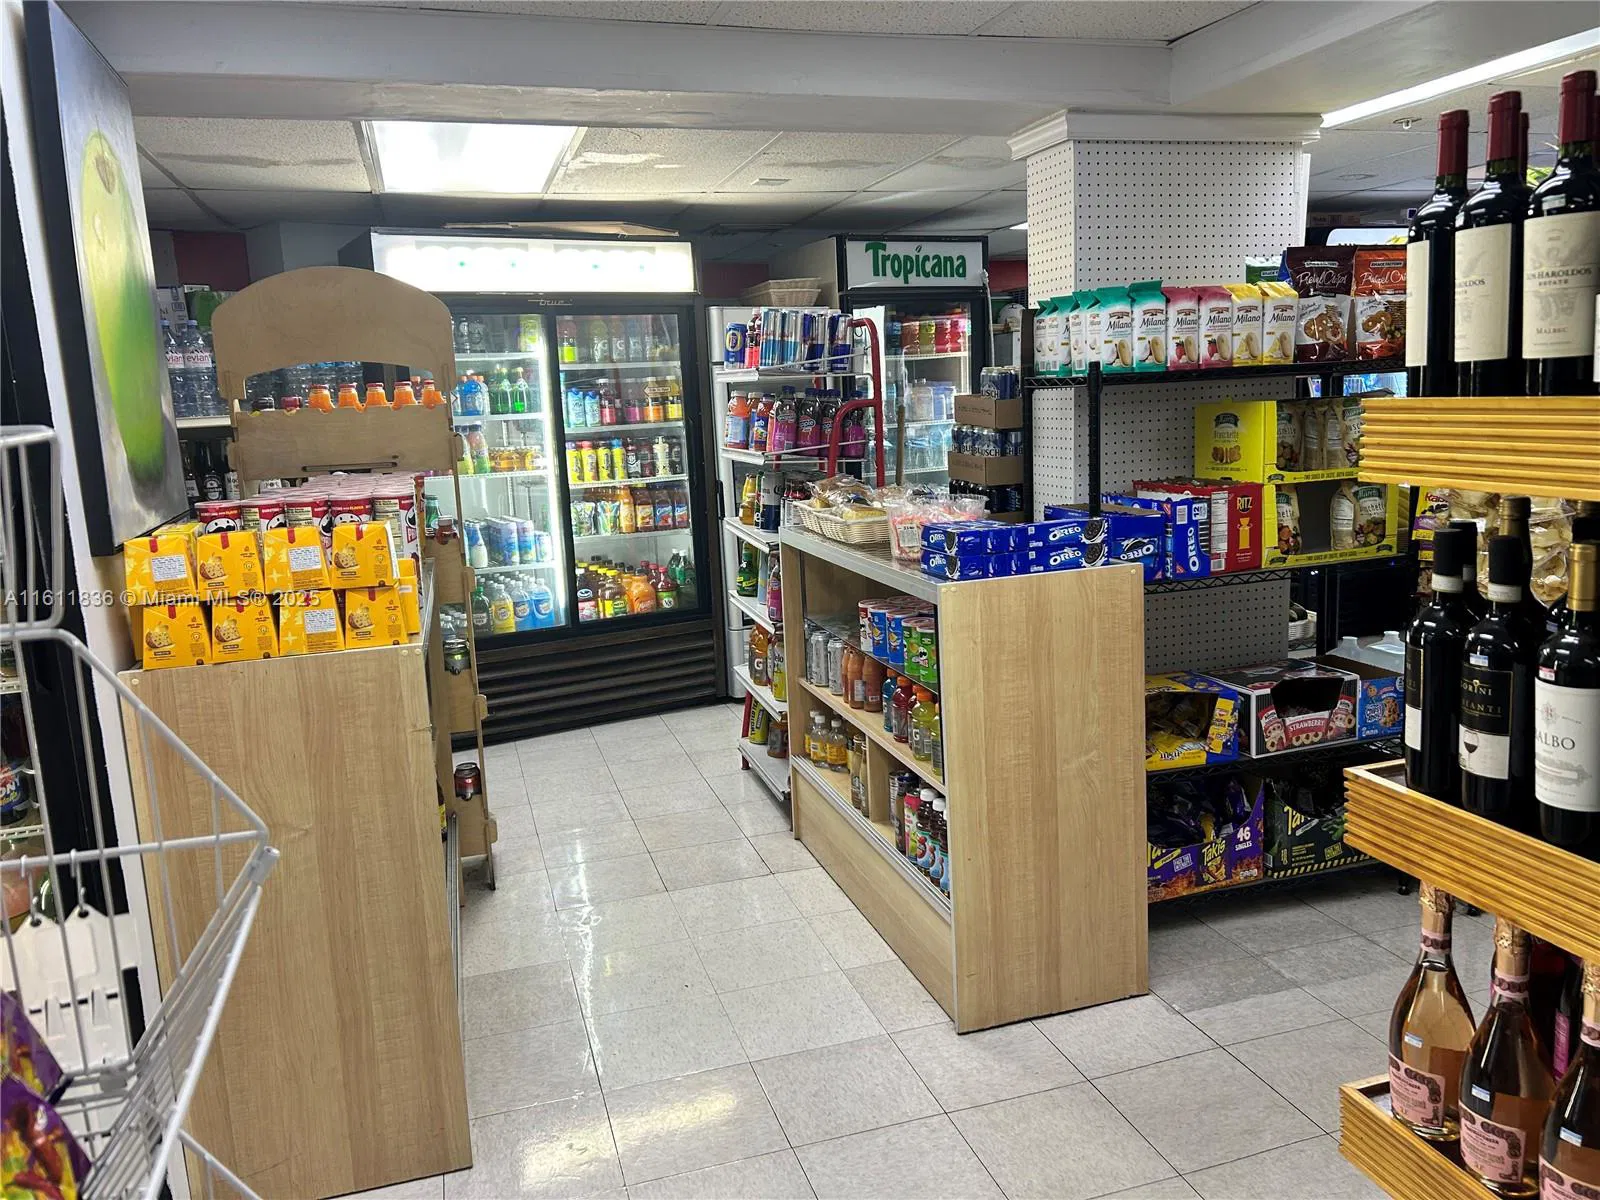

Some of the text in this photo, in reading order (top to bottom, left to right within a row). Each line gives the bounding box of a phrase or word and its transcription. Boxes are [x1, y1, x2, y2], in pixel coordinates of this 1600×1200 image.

[865, 241, 967, 284] Tropicana
[1139, 318, 1166, 329] Milano
[1206, 315, 1232, 325] Milano
[1234, 315, 1261, 325] Milano
[1269, 313, 1296, 323] Milano
[1106, 321, 1132, 332] Milano
[1237, 496, 1252, 511] RITZ
[929, 533, 946, 543] OREO
[1049, 526, 1081, 541] OREO
[1120, 544, 1154, 560] OREO
[1188, 527, 1199, 572] OREO
[1049, 550, 1082, 566] OREO
[754, 658, 763, 670] G
[1289, 720, 1325, 732] STRAWBERRY
[913, 729, 920, 741] G
[1236, 826, 1251, 841] 46
